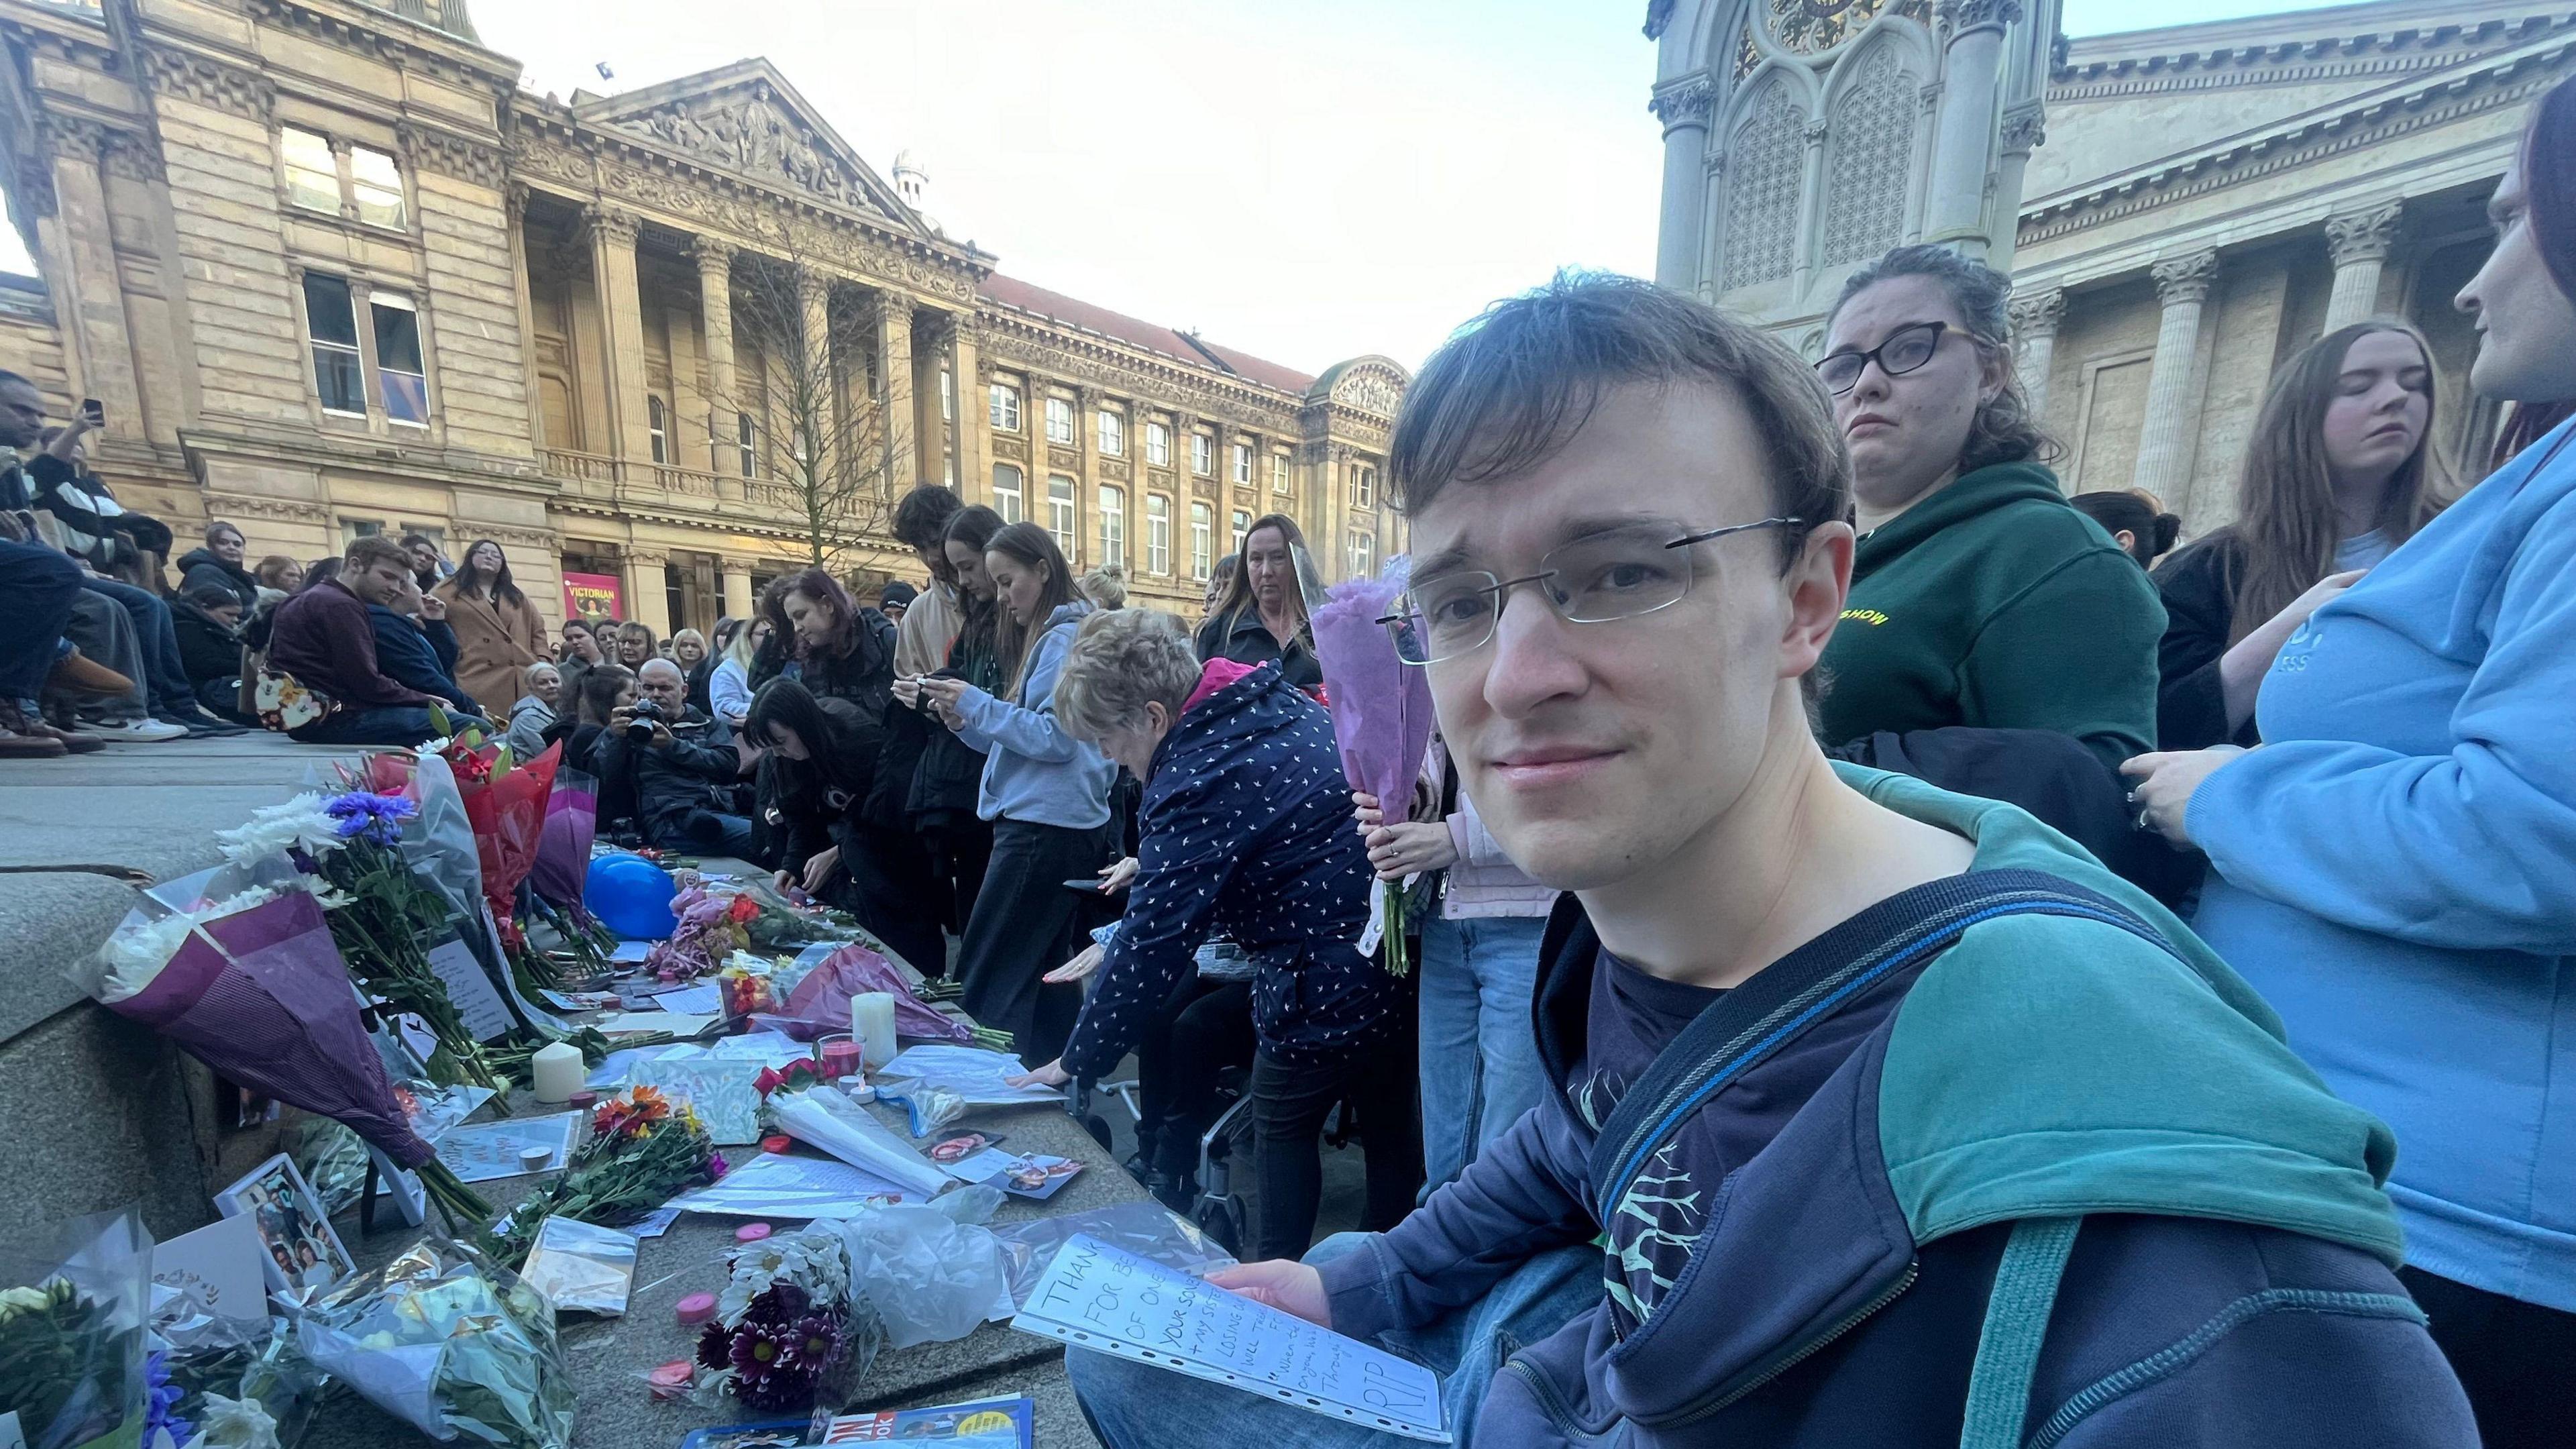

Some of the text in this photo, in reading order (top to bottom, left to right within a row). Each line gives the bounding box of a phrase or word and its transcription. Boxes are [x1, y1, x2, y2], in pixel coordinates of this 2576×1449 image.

[569, 586, 615, 600] VICTORIAN
[1839, 609, 1889, 625] SHOW
[1040, 1242, 1106, 1309] THANK
[1083, 1283, 1123, 1327] FOR
[1125, 1311, 1146, 1340] OF
[1159, 1309, 1187, 1348] YOUR
[1195, 1320, 1215, 1343] MY
[1215, 1312, 1242, 1358] LOSING
[1240, 1339, 1259, 1366] WILL
[1363, 1361, 1426, 1421] RIP
